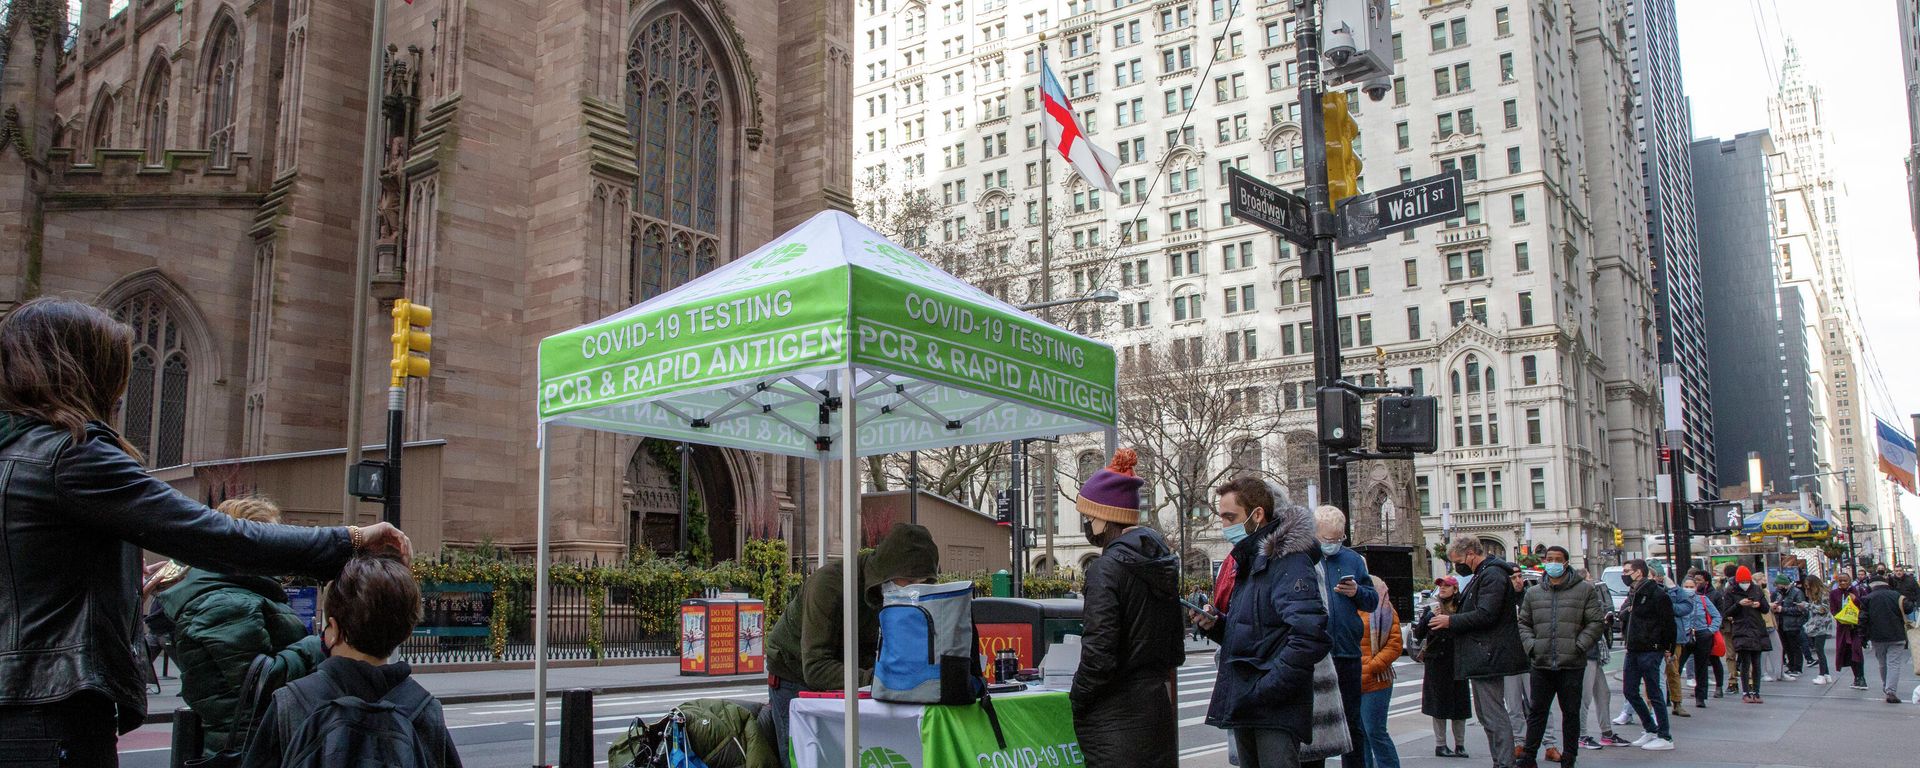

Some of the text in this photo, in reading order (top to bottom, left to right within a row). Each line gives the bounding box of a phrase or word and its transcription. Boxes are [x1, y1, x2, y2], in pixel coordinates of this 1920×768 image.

[1240, 187, 1286, 225] Broadway
[1388, 188, 1444, 221] Wall ST
[1403, 188, 1415, 198] 1-21
[582, 289, 793, 359] COVID-19 TESTING
[904, 292, 1084, 368] COVID-19 TESTING
[544, 325, 843, 409] PCR & RAPID ANTIGEN
[859, 324, 920, 365] PCR
[926, 342, 946, 371] &
[951, 348, 1022, 389] RAPID
[1028, 370, 1114, 416] ANTIGEN
[976, 742, 1085, 768] COVID-19 TE
